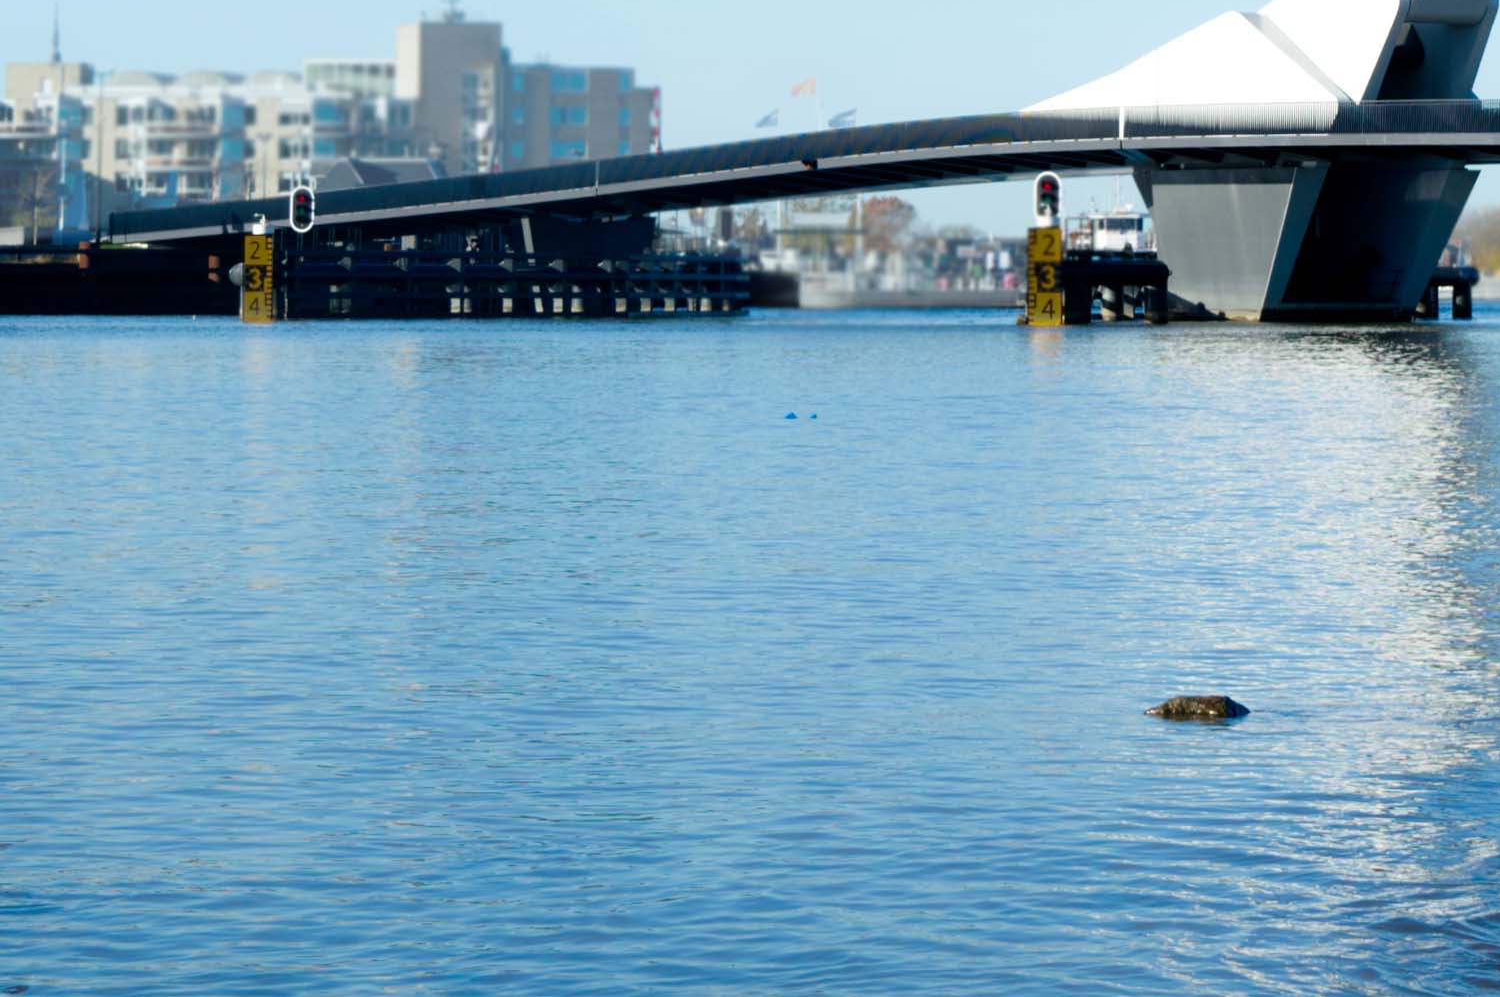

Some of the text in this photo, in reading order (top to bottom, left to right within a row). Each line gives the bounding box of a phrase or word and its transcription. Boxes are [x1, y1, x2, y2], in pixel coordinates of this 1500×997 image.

[250, 241, 260, 259] 2
[1042, 234, 1055, 256] 2
[248, 268, 261, 290] 3
[1041, 265, 1056, 288] 3
[249, 297, 259, 315] 4
[1042, 298, 1055, 320] 4
